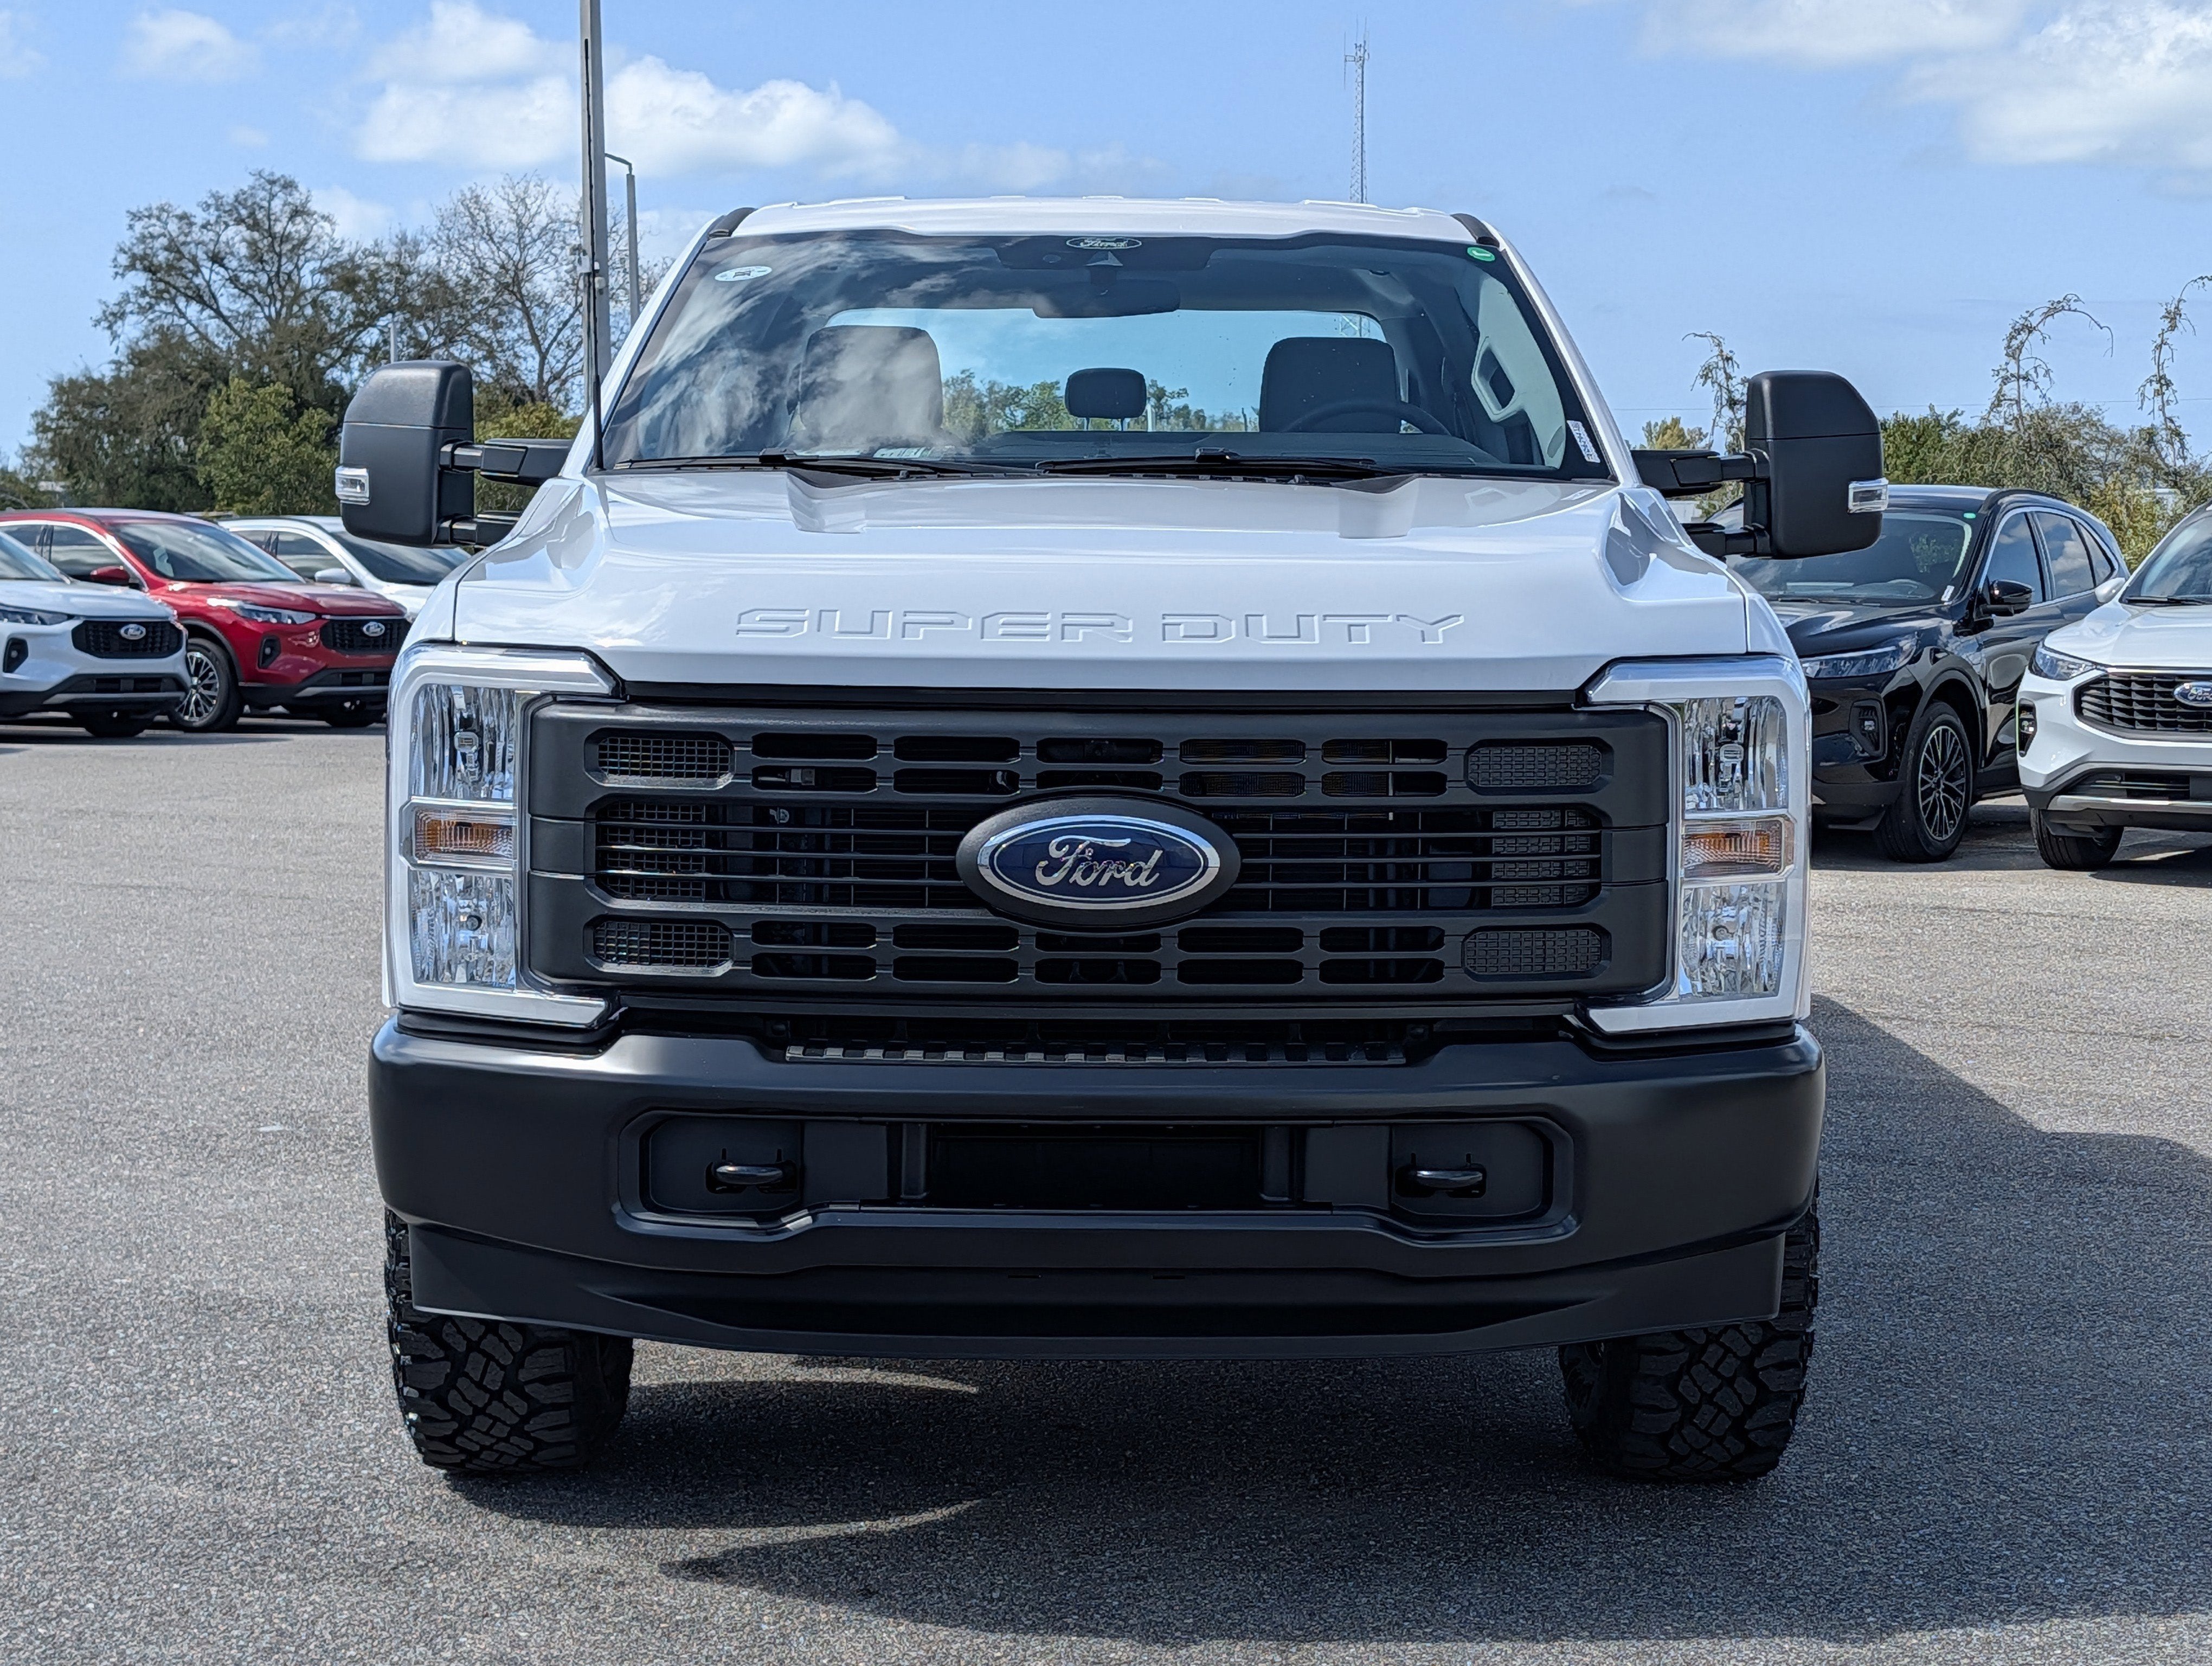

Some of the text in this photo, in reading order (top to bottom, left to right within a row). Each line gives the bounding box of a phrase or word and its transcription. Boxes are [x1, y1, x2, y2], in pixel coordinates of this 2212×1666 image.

[735, 607, 1465, 644] SUPER DUTY
[1034, 834, 1164, 887] Ford
